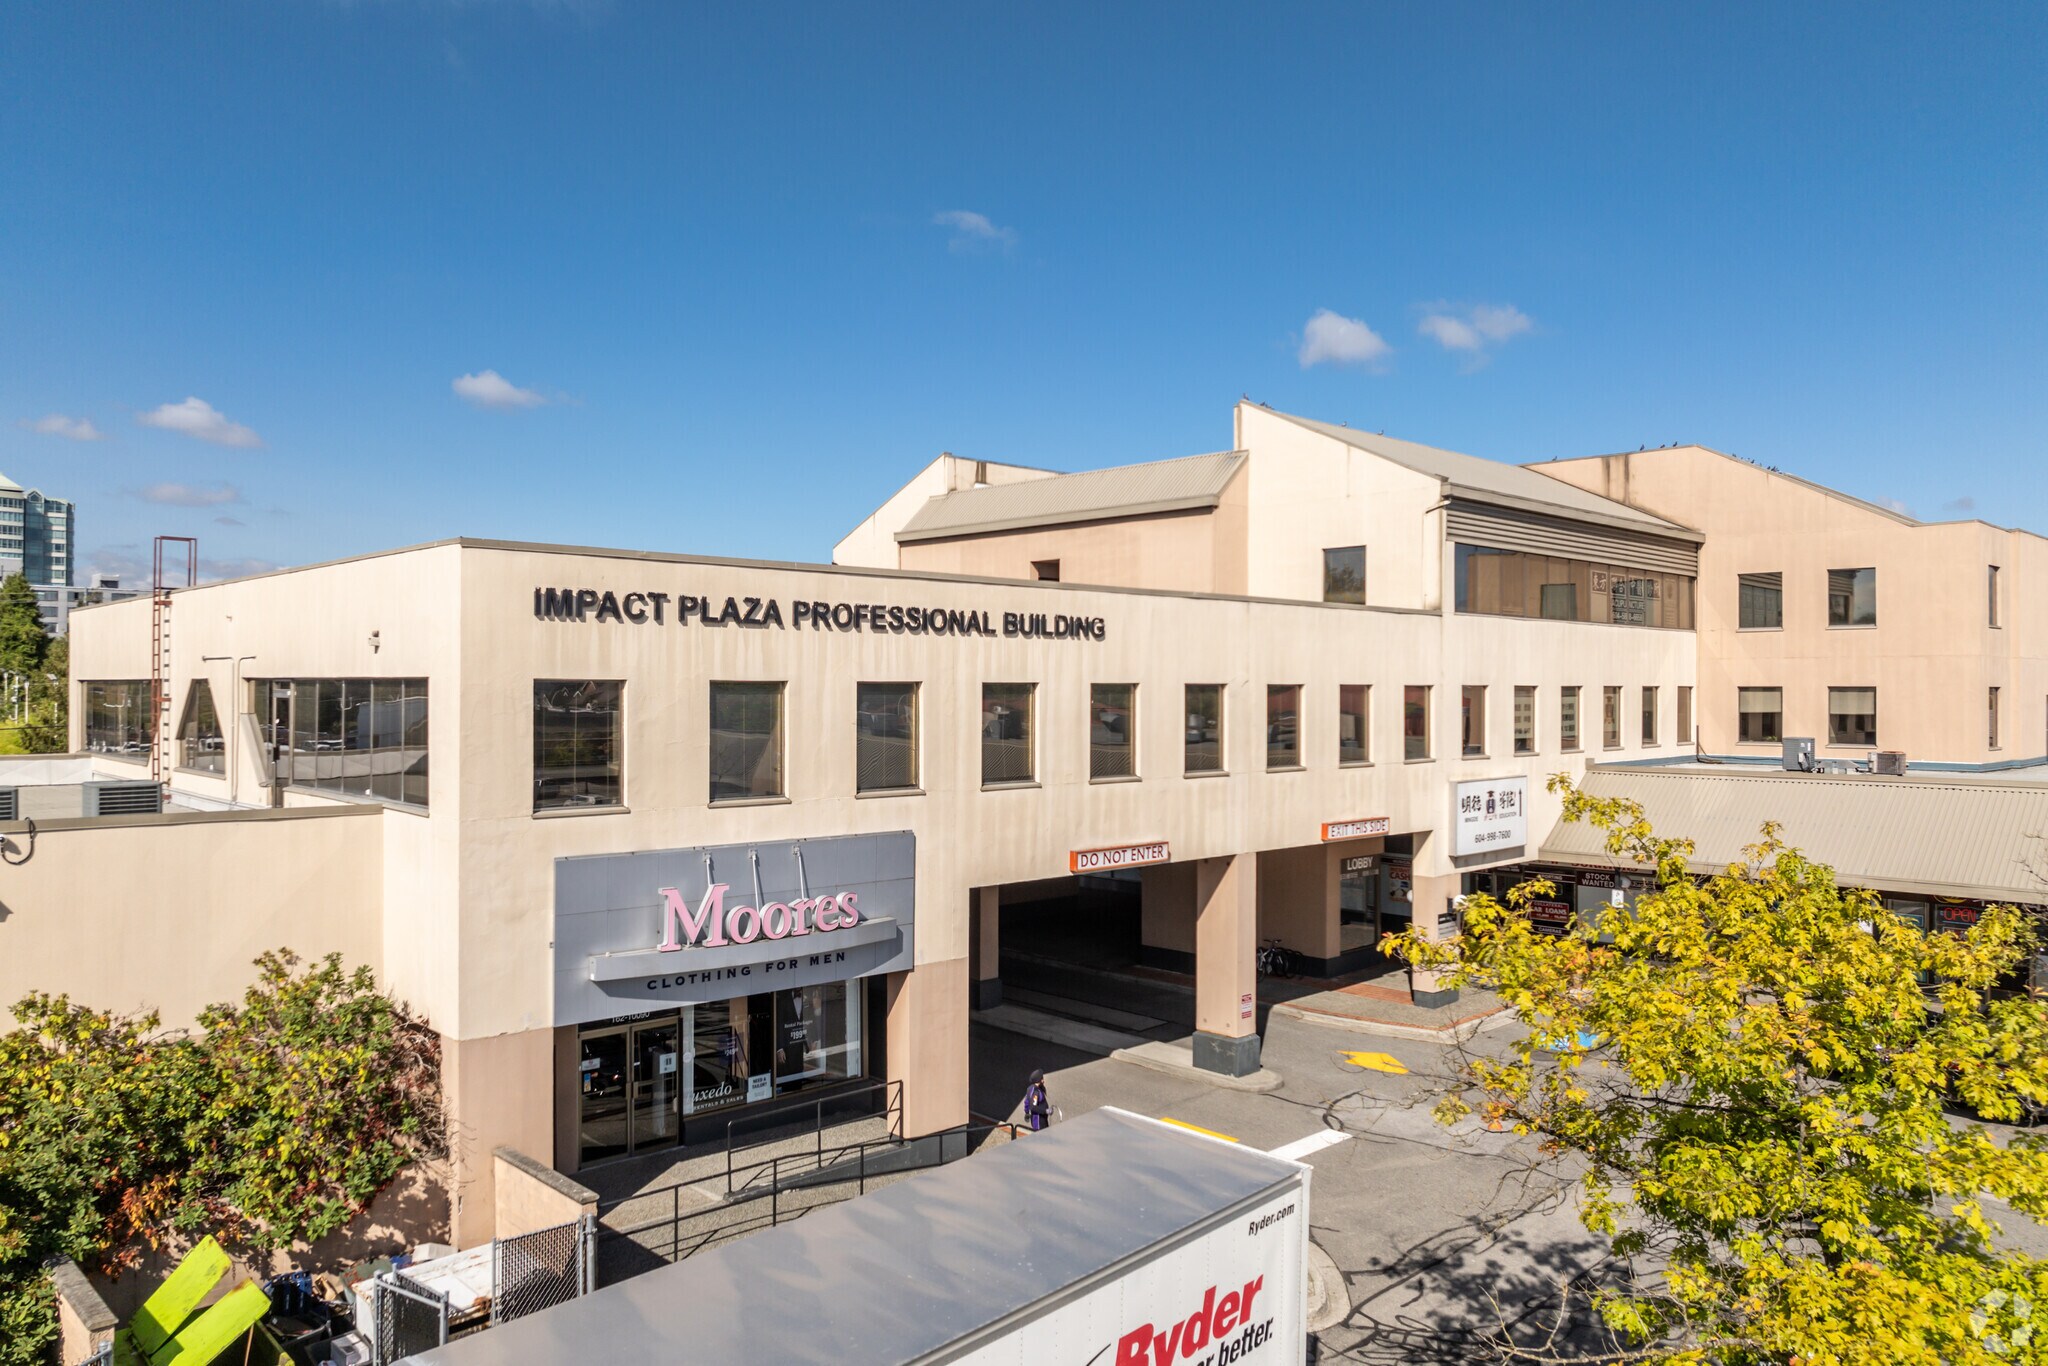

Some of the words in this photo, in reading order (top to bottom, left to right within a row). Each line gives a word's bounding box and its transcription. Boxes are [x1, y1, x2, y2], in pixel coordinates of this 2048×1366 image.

[534, 587, 670, 625] IMPACT
[678, 595, 785, 630] PLAZA
[792, 600, 997, 637] PROFESSIONAL
[1003, 611, 1106, 641] BUILDING
[1331, 825, 1349, 838] EXIT
[1351, 822, 1367, 836] THIS
[1369, 819, 1386, 833] SIDE
[1080, 853, 1099, 868] DO
[1102, 849, 1128, 865] NOT
[1130, 845, 1164, 862] ENTER
[1346, 856, 1373, 871] LOBBY
[1390, 871, 1410, 881] CASH
[1538, 873, 1563, 881] PORTING
[1582, 878, 1615, 888] WANTED
[1585, 872, 1610, 881] STOCK
[657, 883, 859, 952] Moores
[1545, 907, 1567, 915] LOANS
[1943, 907, 1977, 923] OPEN
[647, 965, 751, 990] CLOTHING
[765, 959, 799, 973] FOR
[809, 951, 846, 966] MEN
[1249, 1203, 1294, 1236] Ryder.com
[1115, 1274, 1263, 1366] Ryder
[1218, 1317, 1274, 1366] better.
